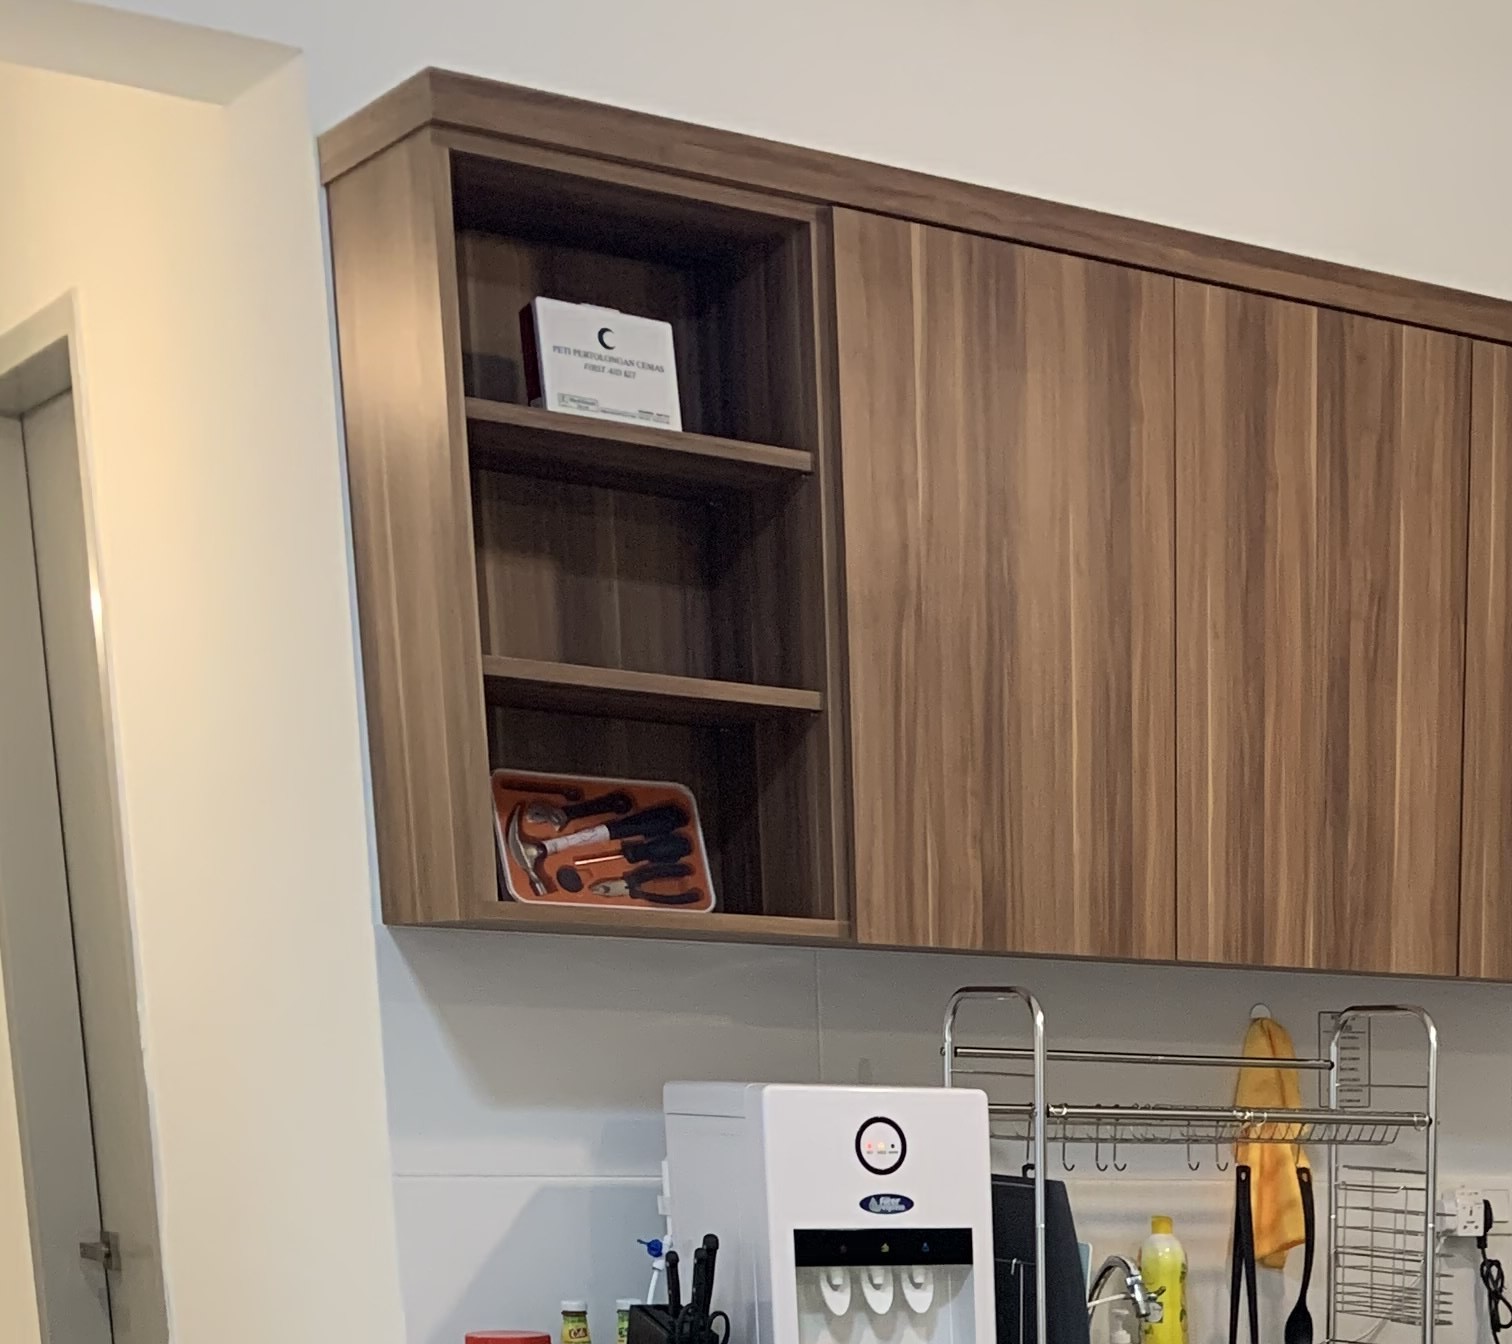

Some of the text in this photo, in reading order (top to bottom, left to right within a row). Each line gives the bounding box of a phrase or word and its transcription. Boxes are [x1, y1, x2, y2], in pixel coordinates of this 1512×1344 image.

[552, 345, 665, 373] PETI PERTOLONGAN CEMAS
[584, 362, 606, 374] FIRST
[607, 368, 622, 376] AID
